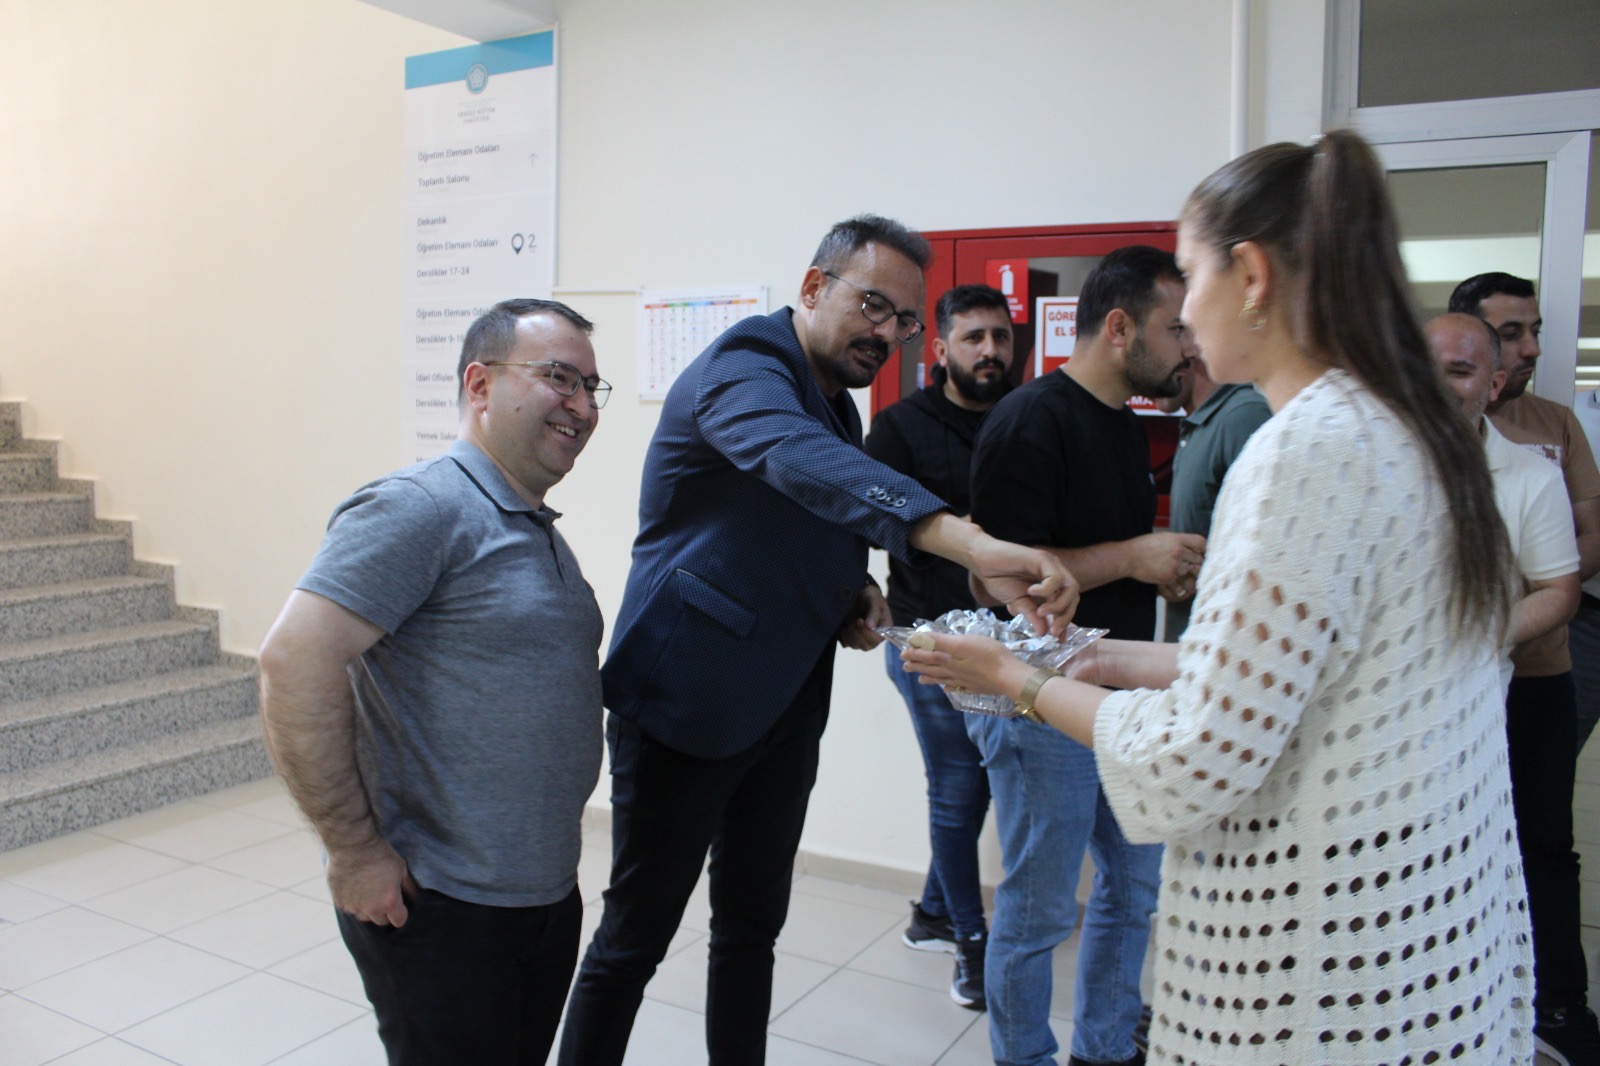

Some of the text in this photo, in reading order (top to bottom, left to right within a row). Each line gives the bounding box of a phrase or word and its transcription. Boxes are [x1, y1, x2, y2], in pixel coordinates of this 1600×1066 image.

[417, 144, 499, 162] Öğretim Elemanı Odaları
[417, 174, 470, 188] Toplantı Salonu
[417, 216, 447, 226] Dekanlık
[416, 238, 498, 254] Öğretim Elemanı Odaları
[528, 234, 537, 249] 2
[416, 266, 470, 278] Derslikler 17-24
[416, 308, 442, 320] Öğretim
[443, 308, 471, 317] Elemanı
[1048, 309, 1077, 321] GÖRE
[1054, 326, 1066, 337] EL
[415, 334, 446, 344] Derslikler
[415, 371, 454, 382] İdari Ofisler
[415, 398, 446, 408] Derslikler
[415, 431, 438, 441] Yemek
